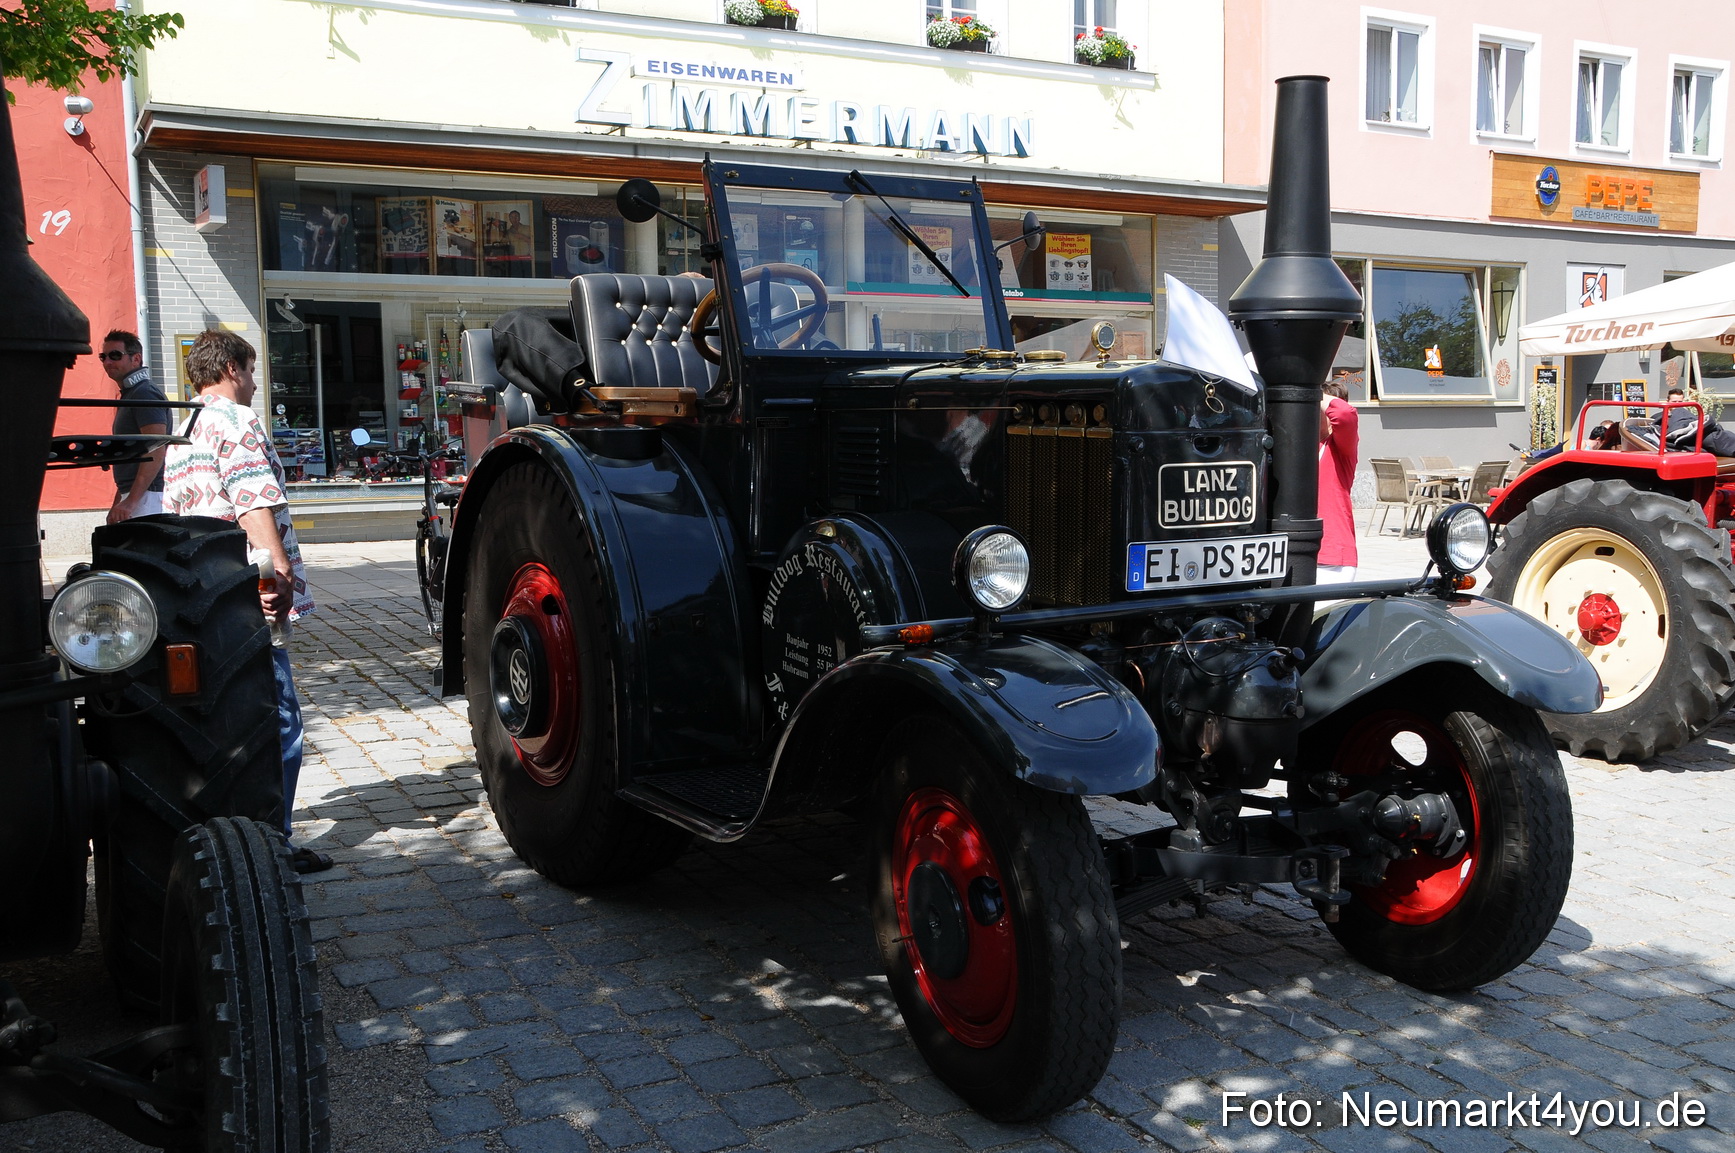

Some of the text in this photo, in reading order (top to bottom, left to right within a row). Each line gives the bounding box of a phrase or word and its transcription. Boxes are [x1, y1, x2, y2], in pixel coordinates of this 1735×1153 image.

[647, 60, 794, 86] EISENWAREN
[574, 47, 1035, 158] ZIMMERMANN
[1586, 174, 1654, 208] PEPE
[39, 209, 72, 236] 19
[551, 217, 559, 258] PROXXON
[1048, 247, 1089, 255] Lieblingstopf!
[1564, 320, 1655, 344] Tucher
[1183, 468, 1238, 493] LANZ
[1164, 496, 1252, 523] BULLDOG
[1132, 540, 1286, 584] D EI PS 52H
[785, 632, 833, 658] Baujahr 1952
[782, 660, 809, 680] Hubraum
[784, 646, 809, 667] Leistung
[816, 658, 825, 671] 55
